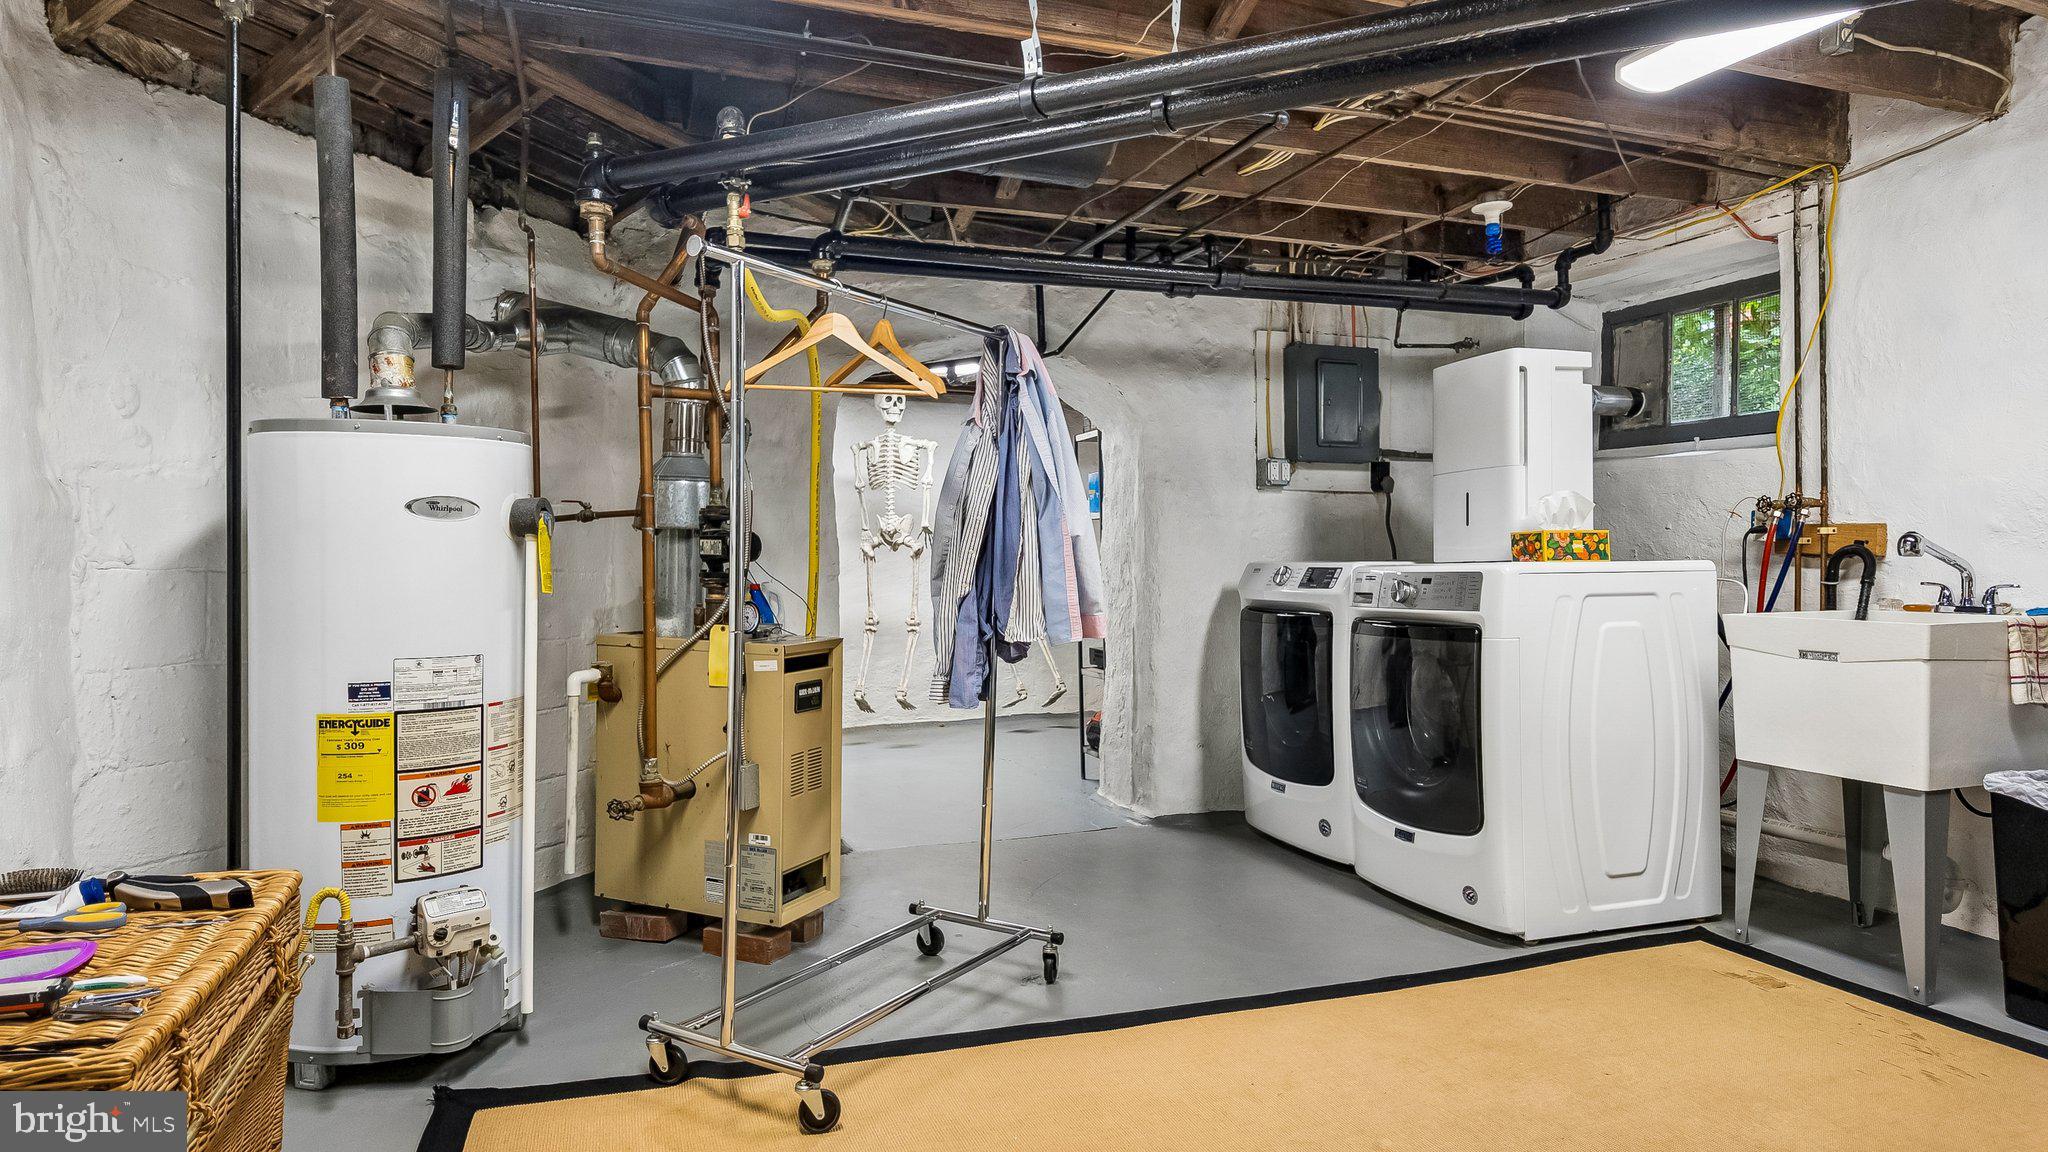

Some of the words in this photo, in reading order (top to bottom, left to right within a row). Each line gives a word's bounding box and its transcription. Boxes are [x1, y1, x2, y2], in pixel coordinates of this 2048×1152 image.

[429, 505, 462, 513] Whirlpool
[319, 718, 391, 730] ENERGYGUIDE
[344, 742, 365, 750] 309
